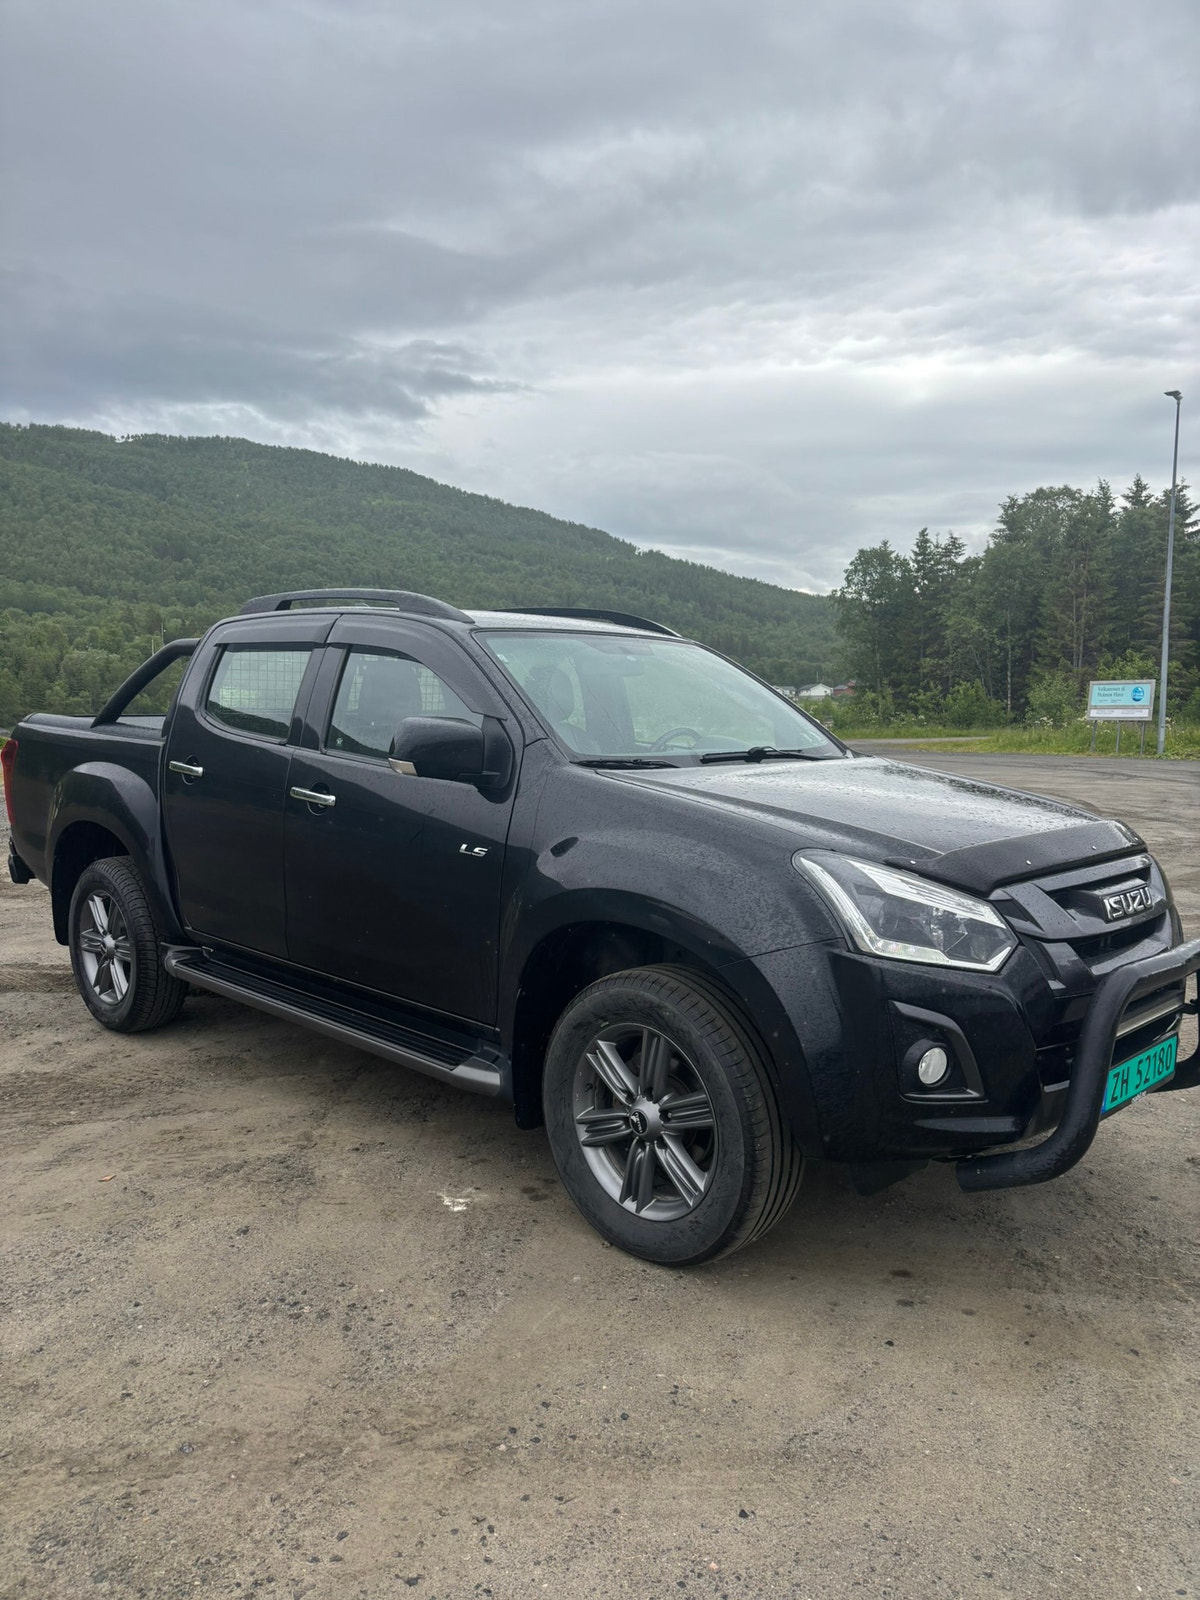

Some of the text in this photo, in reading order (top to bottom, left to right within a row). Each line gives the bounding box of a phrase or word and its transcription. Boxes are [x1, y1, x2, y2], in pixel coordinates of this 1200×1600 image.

[459, 843, 488, 857] LS
[1103, 887, 1152, 920] ISUZU
[1110, 1043, 1173, 1103] ZH 52180
